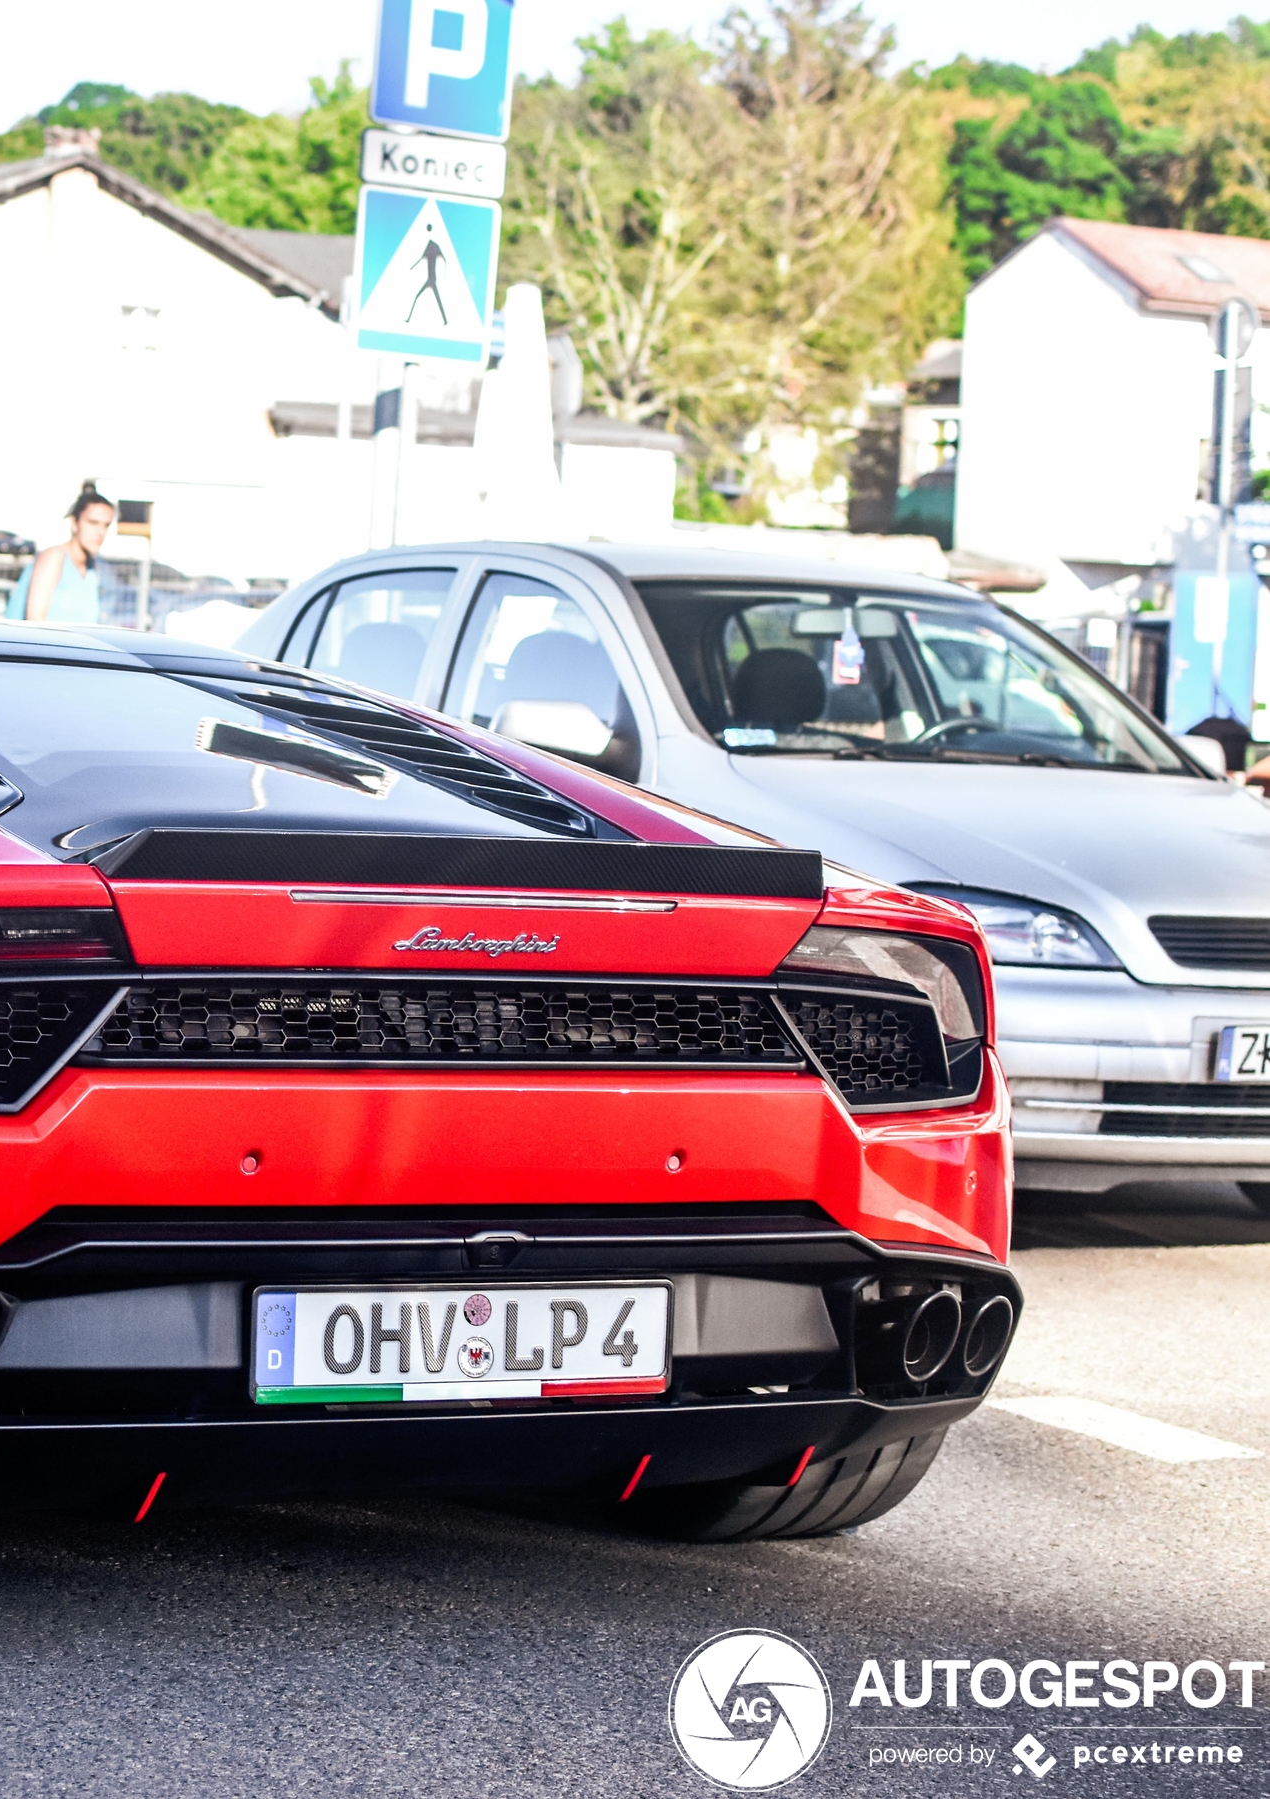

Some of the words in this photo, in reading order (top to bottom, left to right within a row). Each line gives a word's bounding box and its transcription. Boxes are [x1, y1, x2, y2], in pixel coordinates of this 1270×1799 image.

[404, 0, 488, 109] P
[380, 143, 483, 182] Koniec
[391, 926, 560, 957] Lamborghini
[323, 1302, 457, 1375] OHV
[267, 1350, 282, 1370] D
